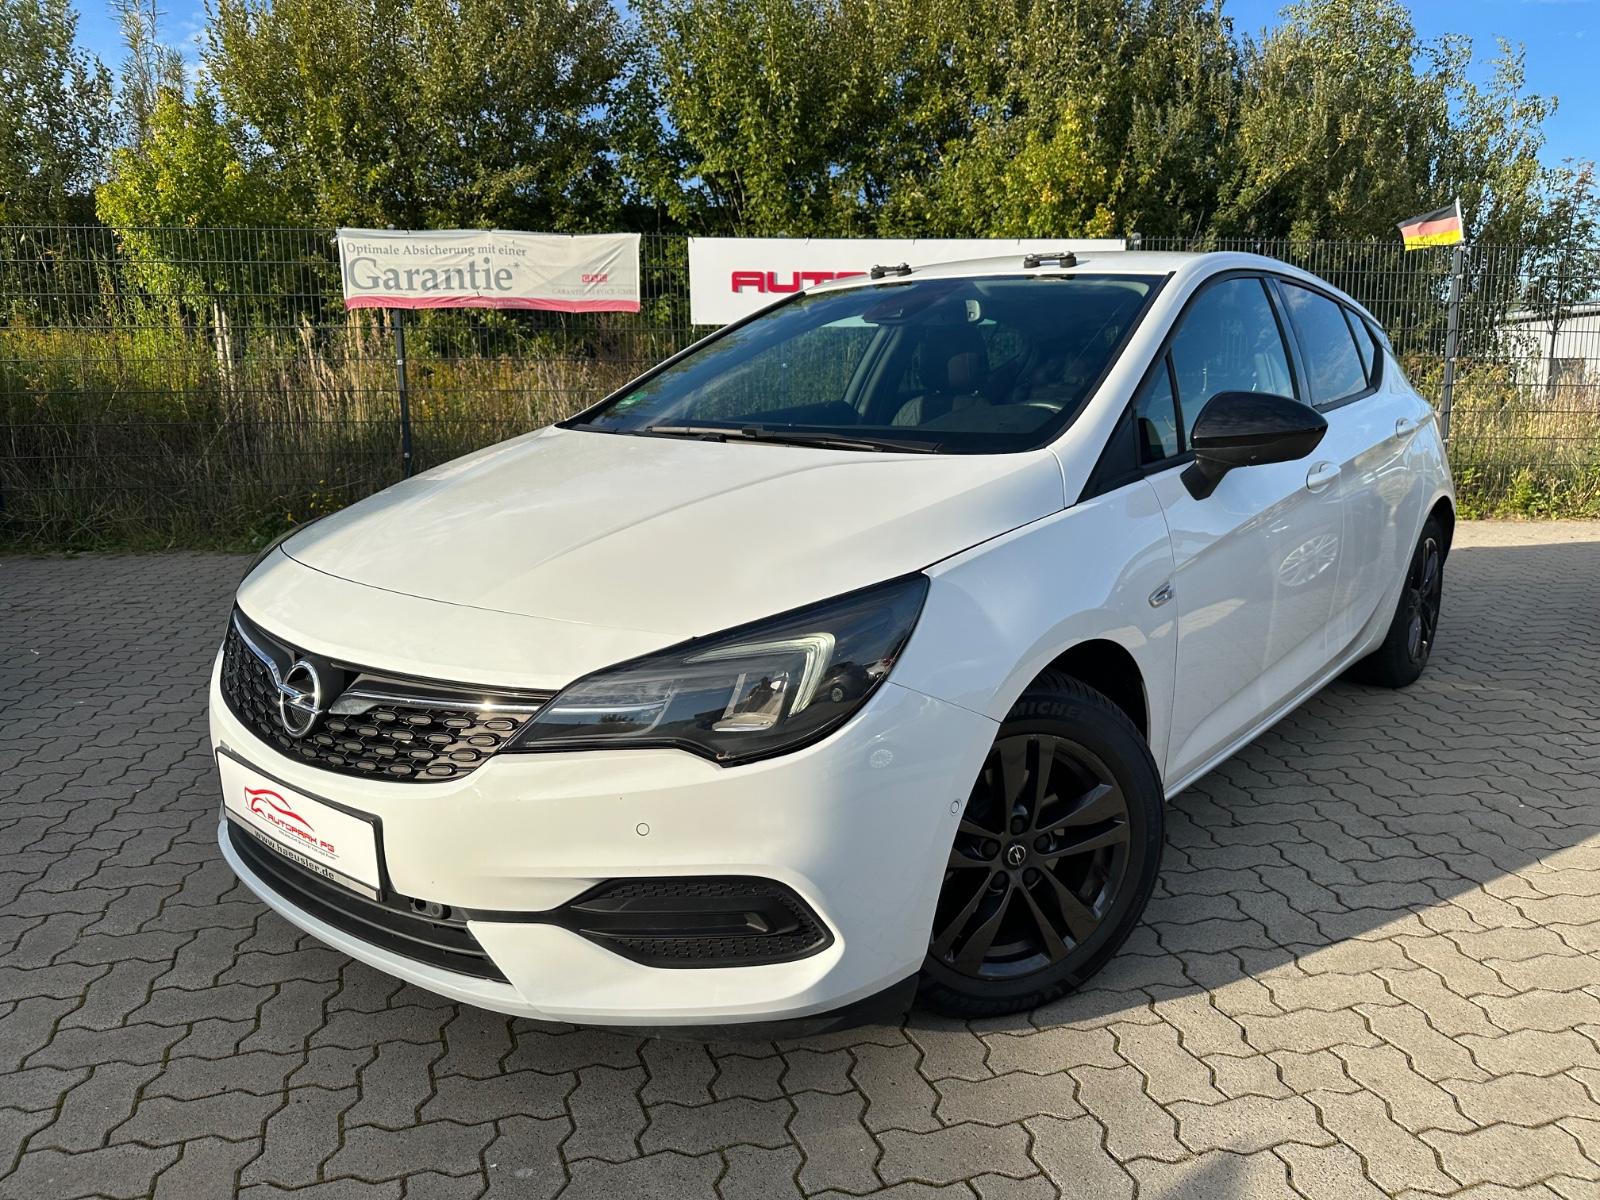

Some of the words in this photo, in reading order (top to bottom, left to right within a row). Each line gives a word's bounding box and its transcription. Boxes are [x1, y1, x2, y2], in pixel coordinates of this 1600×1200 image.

[346, 242, 400, 256] Optimale
[403, 244, 475, 257] Absicherung
[478, 243, 496, 254] mit
[498, 244, 527, 257] einer
[731, 271, 869, 294] AUT
[267, 813, 317, 845] AUTOPARK
[319, 840, 335, 853] PG
[254, 830, 335, 880] www.haeusler.de
